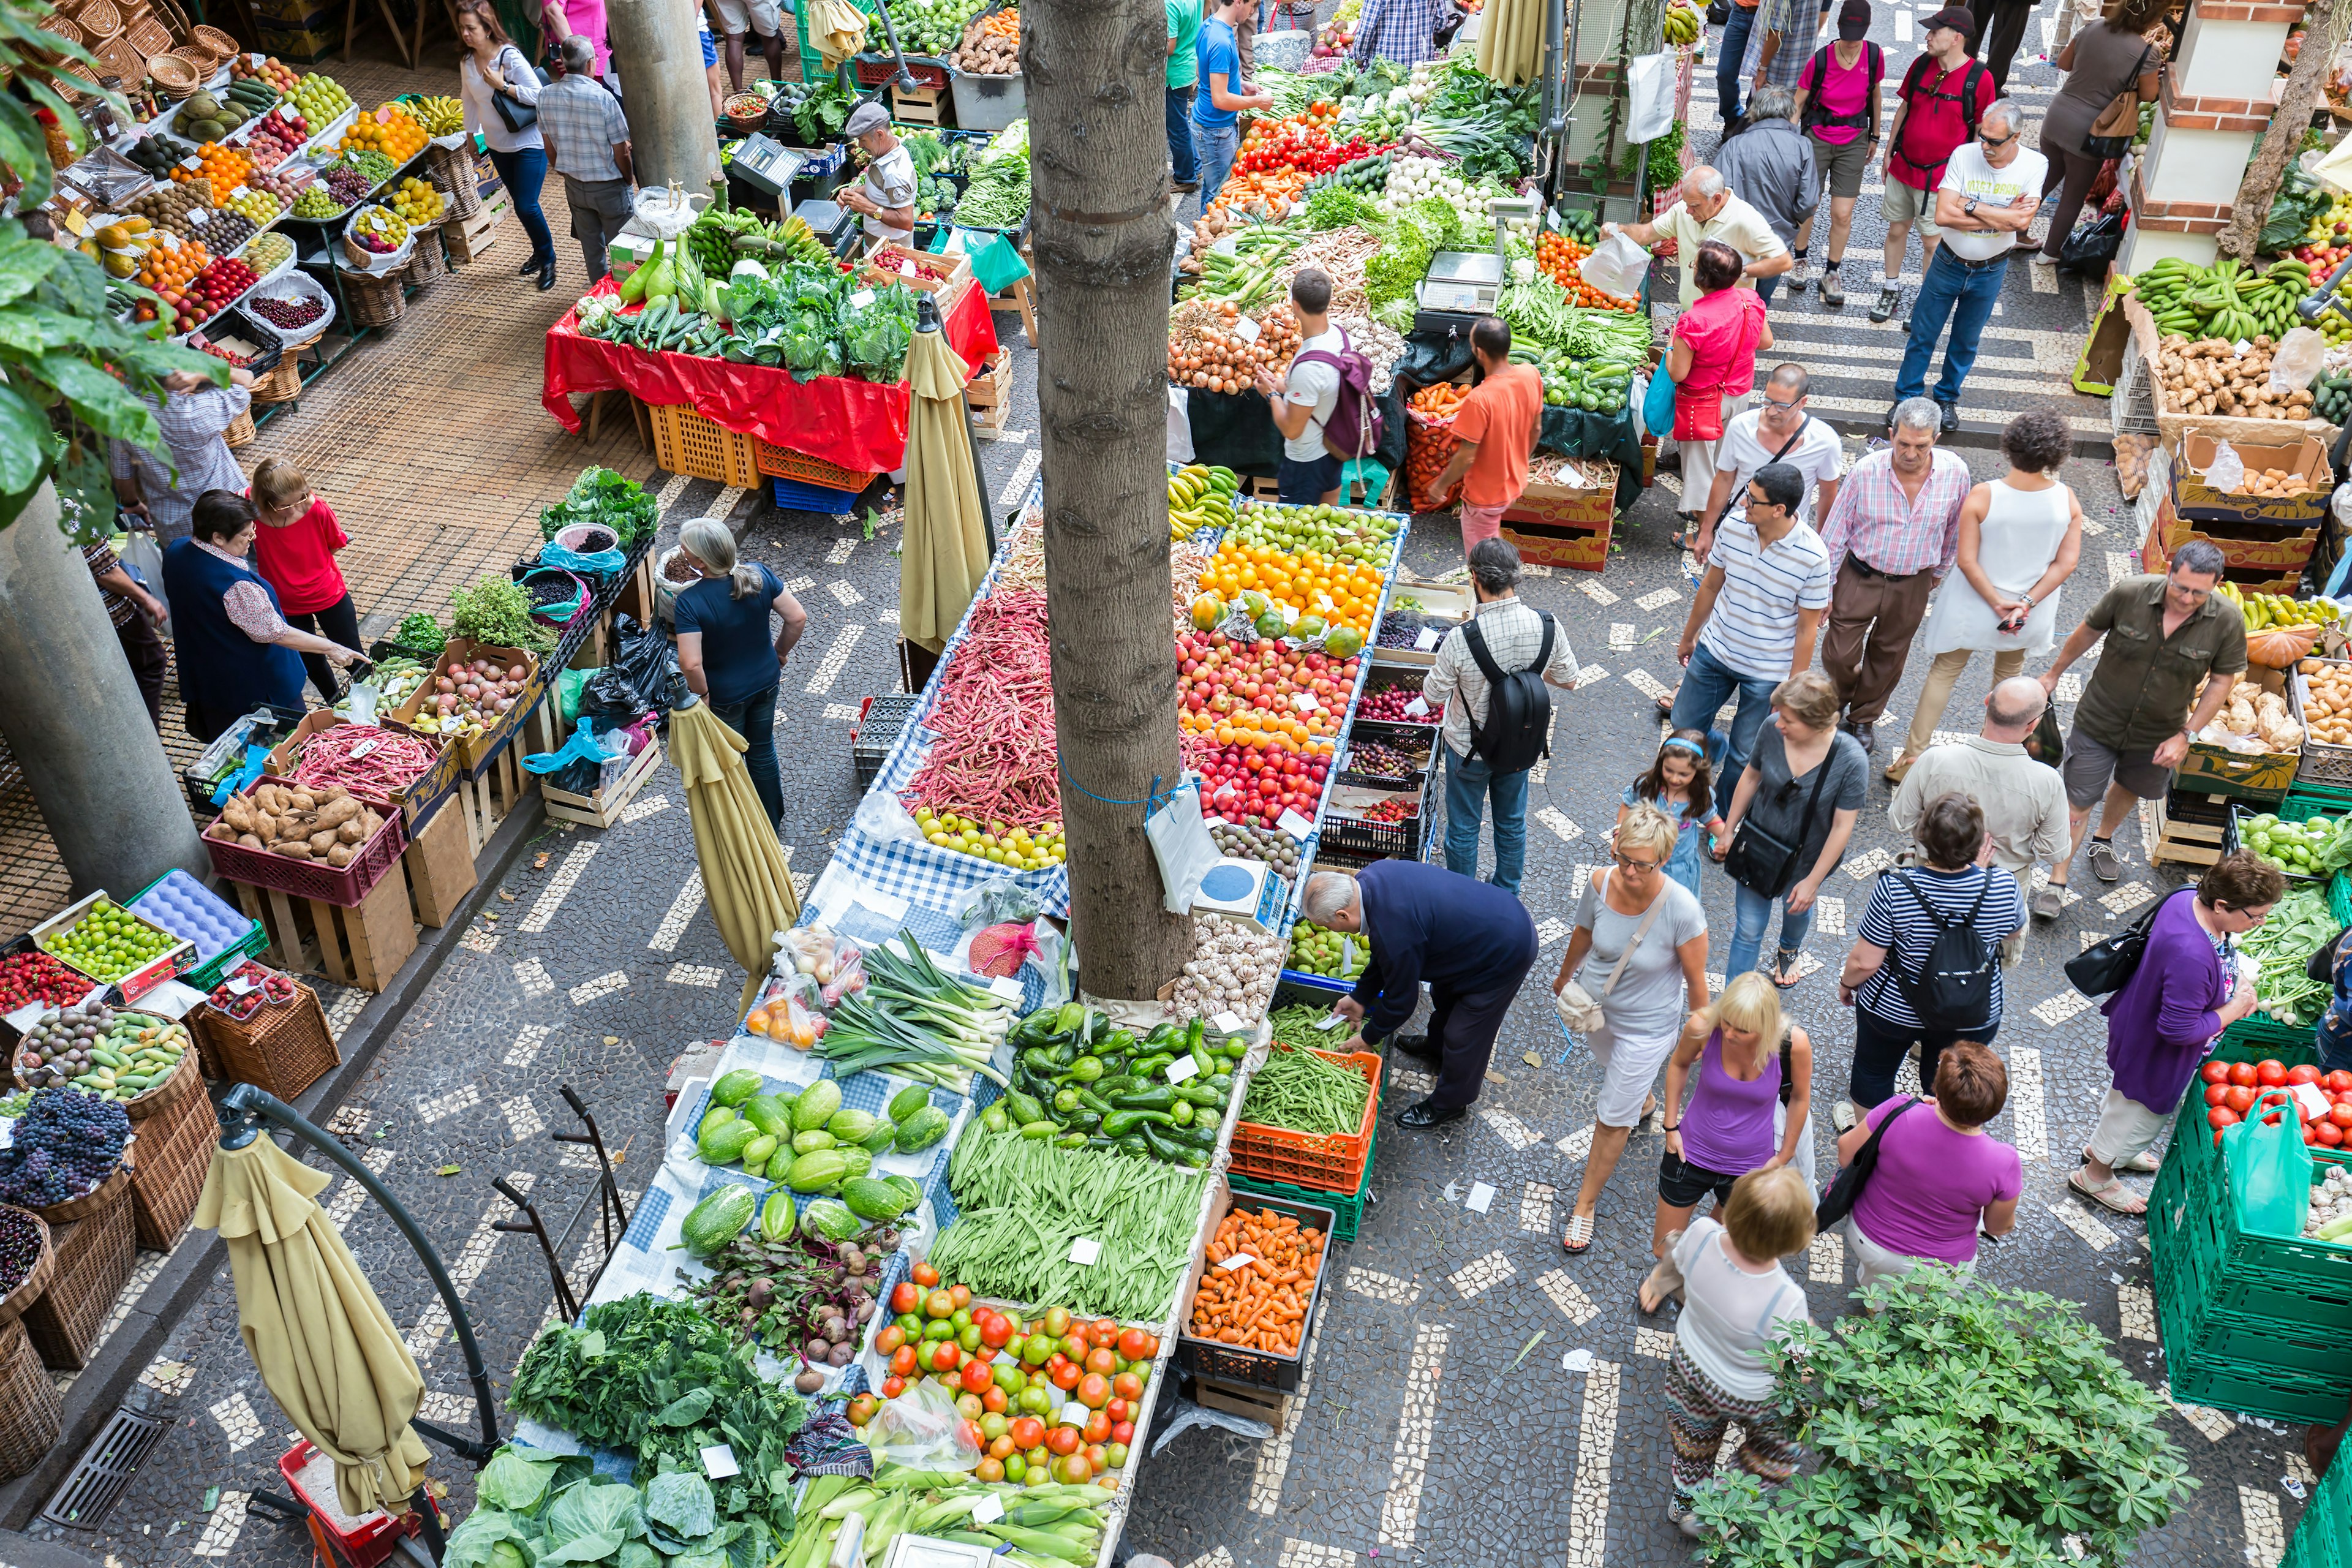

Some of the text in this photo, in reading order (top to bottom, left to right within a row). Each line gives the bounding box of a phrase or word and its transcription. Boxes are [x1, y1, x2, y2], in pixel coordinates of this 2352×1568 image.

[1517, 497, 1547, 506] Banana
[1553, 500, 1585, 509] Madeira
[2216, 494, 2252, 504] Banana
[2259, 497, 2297, 507] Madeira
[1513, 537, 1543, 546] Banana
[1549, 541, 1580, 549] Madeira
[489, 691, 530, 742] Banana Madeira
[2206, 750, 2241, 761] Banana
[2247, 756, 2283, 765] Madeira
